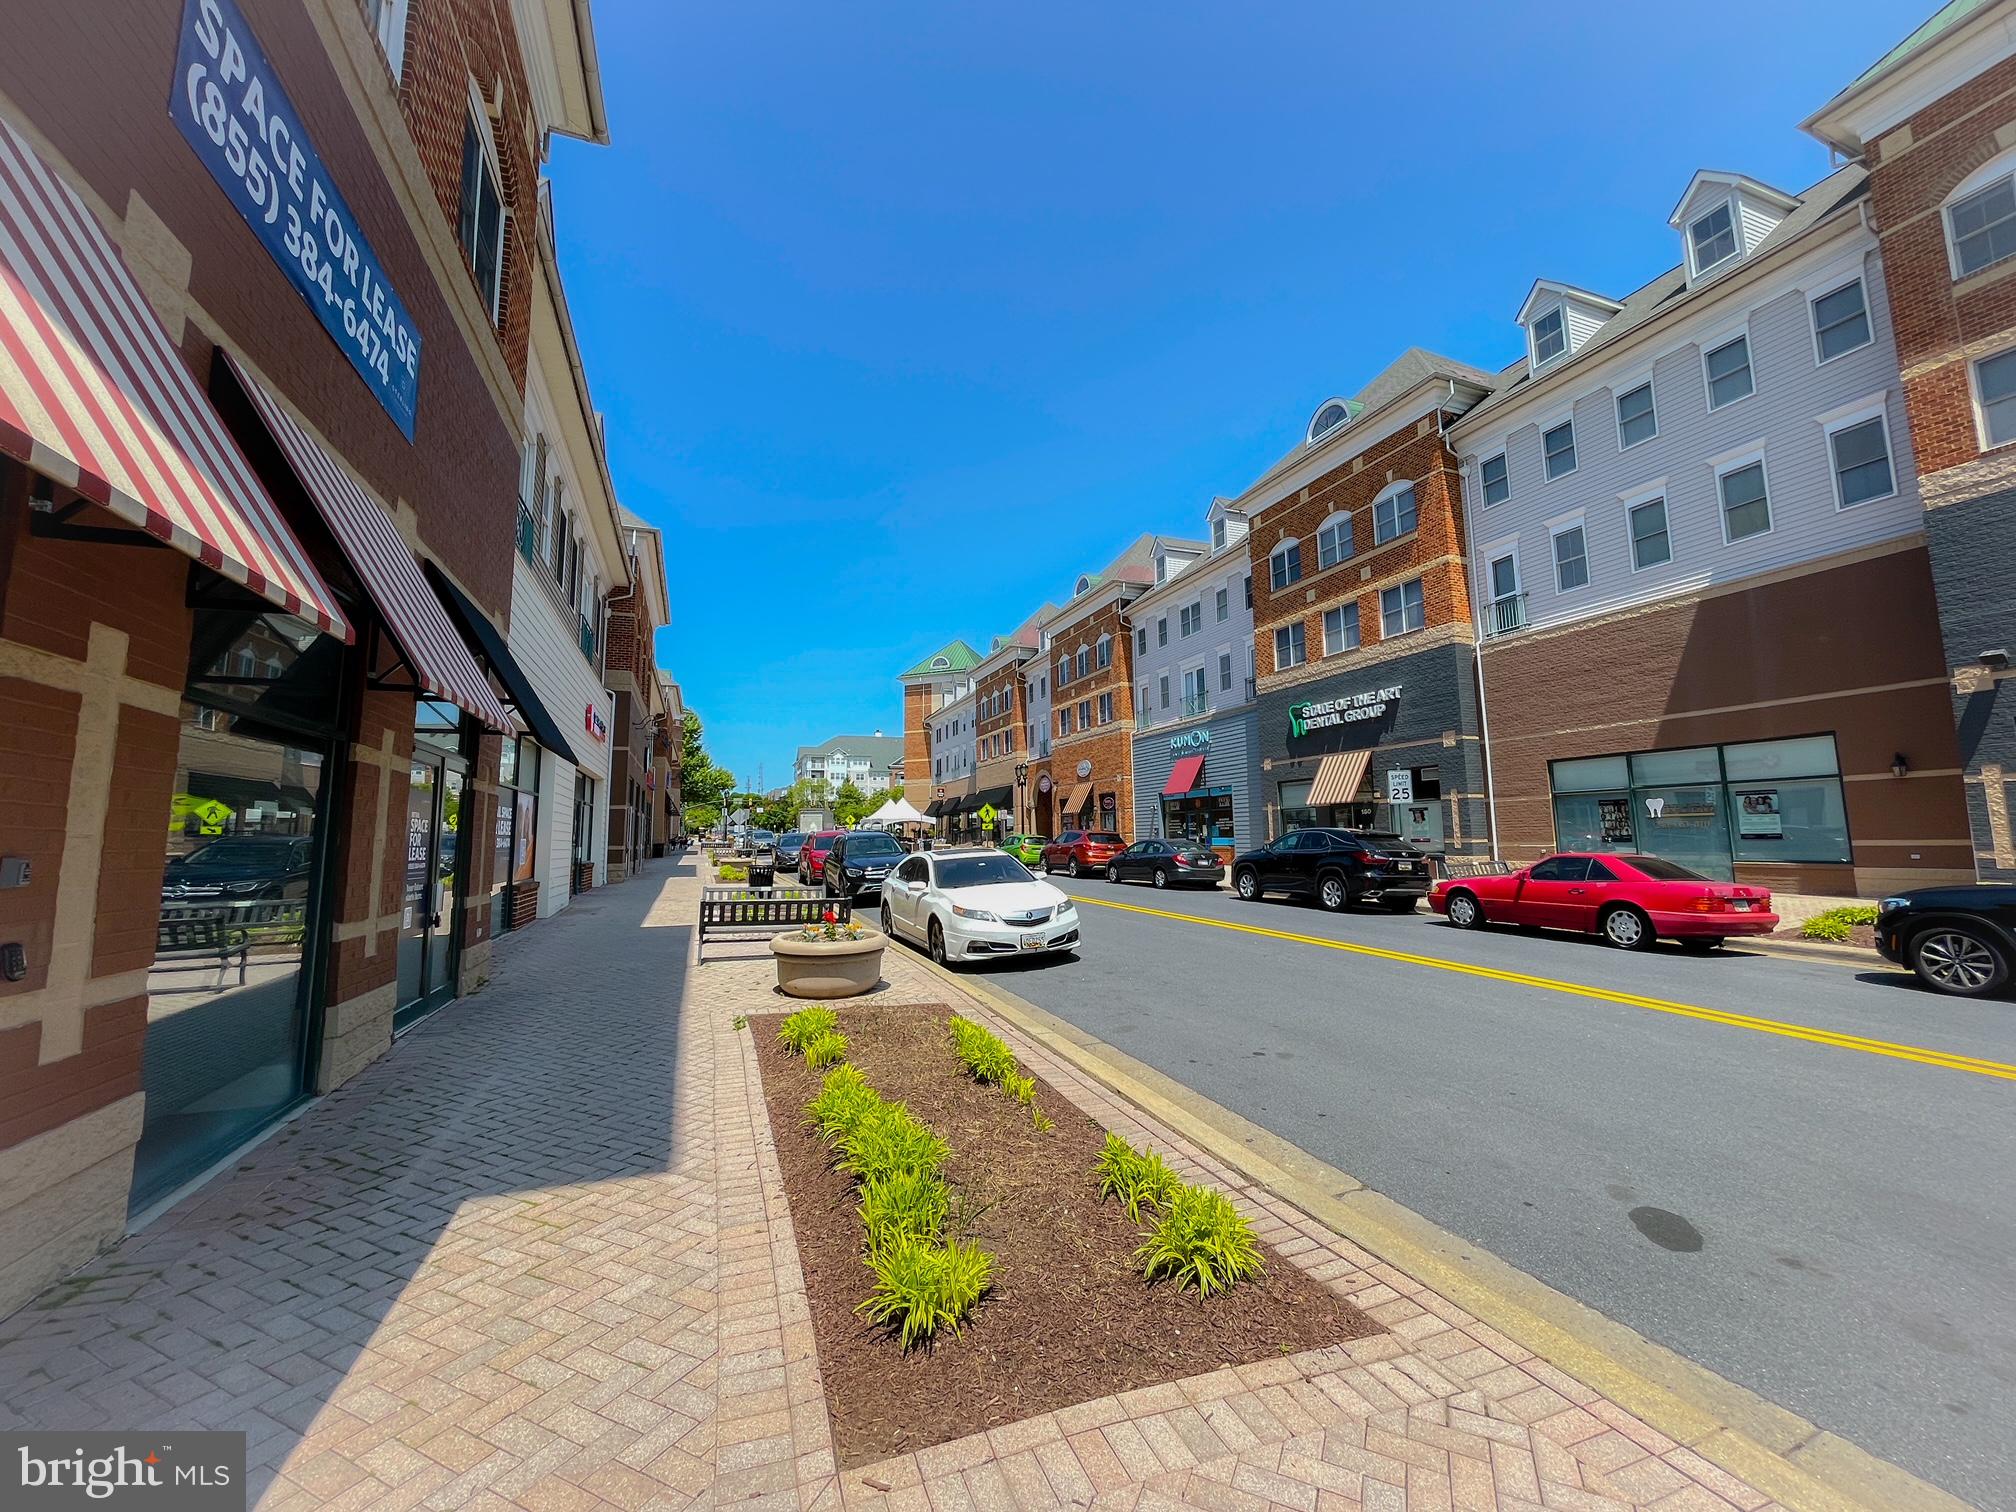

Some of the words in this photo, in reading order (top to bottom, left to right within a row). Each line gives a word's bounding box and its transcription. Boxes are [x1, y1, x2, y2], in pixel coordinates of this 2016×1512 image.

[194, 0, 307, 202] SPACE
[309, 177, 360, 288] FOR
[360, 264, 417, 380] LEASE
[186, 62, 280, 225] (855)
[283, 203, 390, 387] 384-6474
[1302, 700, 1335, 718] STATE
[1334, 696, 1352, 711] OF
[1352, 691, 1376, 708] THE
[1376, 685, 1403, 703] ART
[1303, 712, 1345, 730] DENTAL
[1344, 703, 1387, 723] GROUP
[1170, 730, 1209, 749] KUMON
[1391, 788, 1410, 800] 25
[410, 818, 430, 833] SPACE
[408, 832, 422, 847] FOR
[407, 847, 427, 861] LEASE
